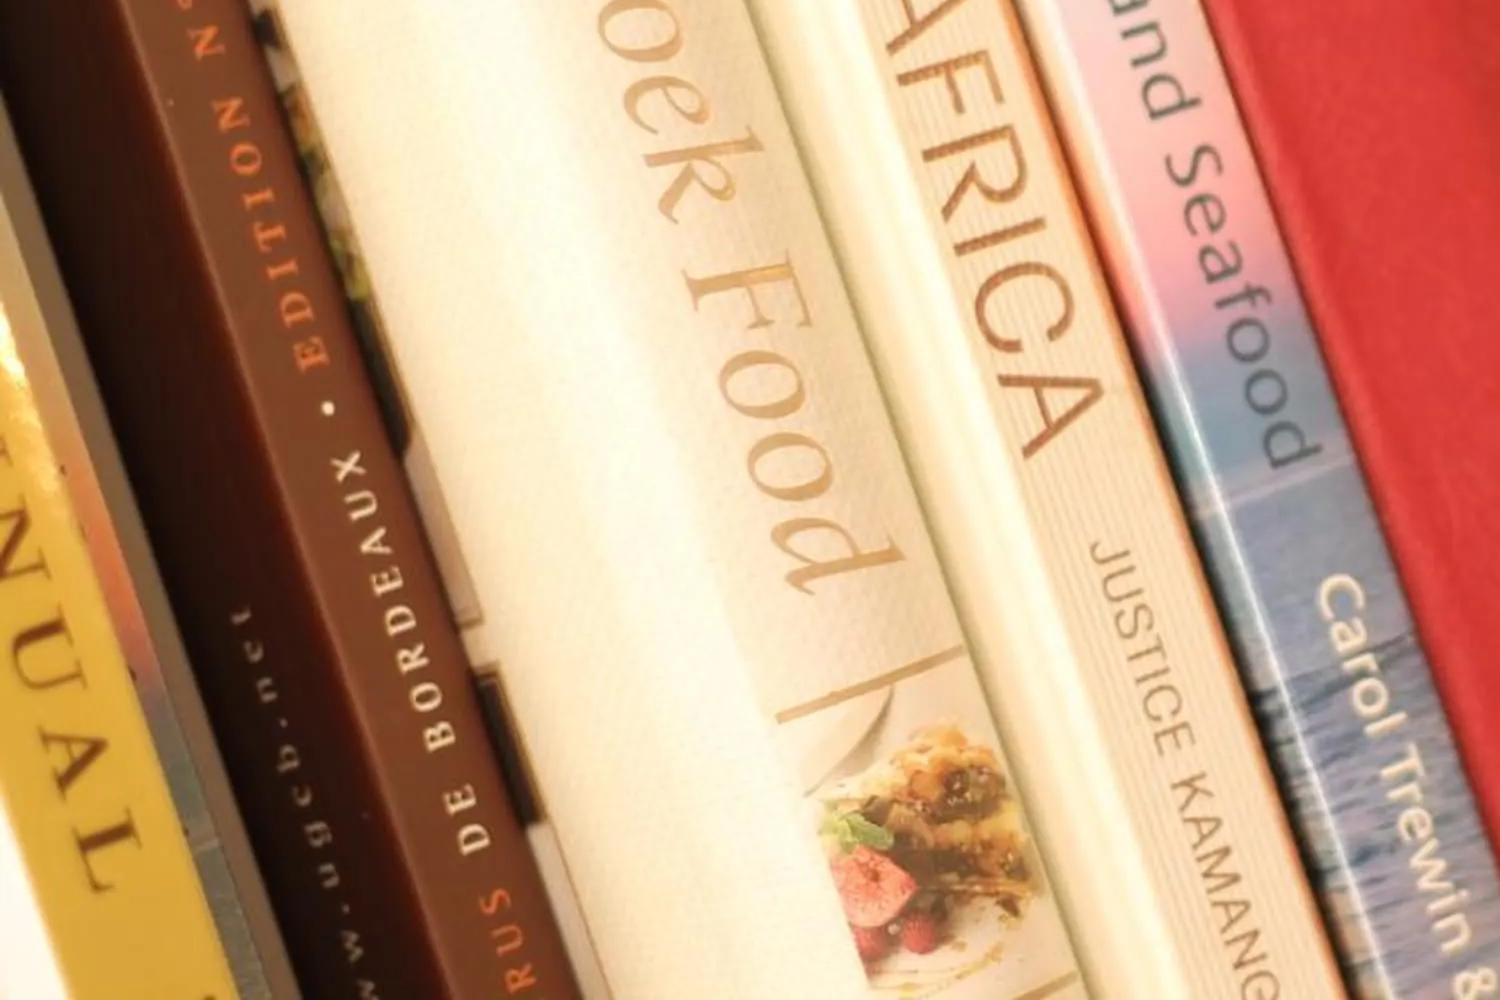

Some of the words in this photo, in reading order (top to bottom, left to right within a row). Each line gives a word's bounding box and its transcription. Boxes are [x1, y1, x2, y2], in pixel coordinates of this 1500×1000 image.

[212, 97, 330, 371] EDITION
[1165, 141, 1323, 469] Seafood
[681, 250, 907, 596] Food
[0, 432, 143, 895] NUAL
[331, 450, 456, 753] BORDEAUX
[1090, 539, 1196, 757] JUSTICE
[443, 782, 492, 856] DE
[1317, 573, 1408, 738] Carol
[1380, 744, 1473, 955] Trewin
[1453, 967, 1498, 1000] &
